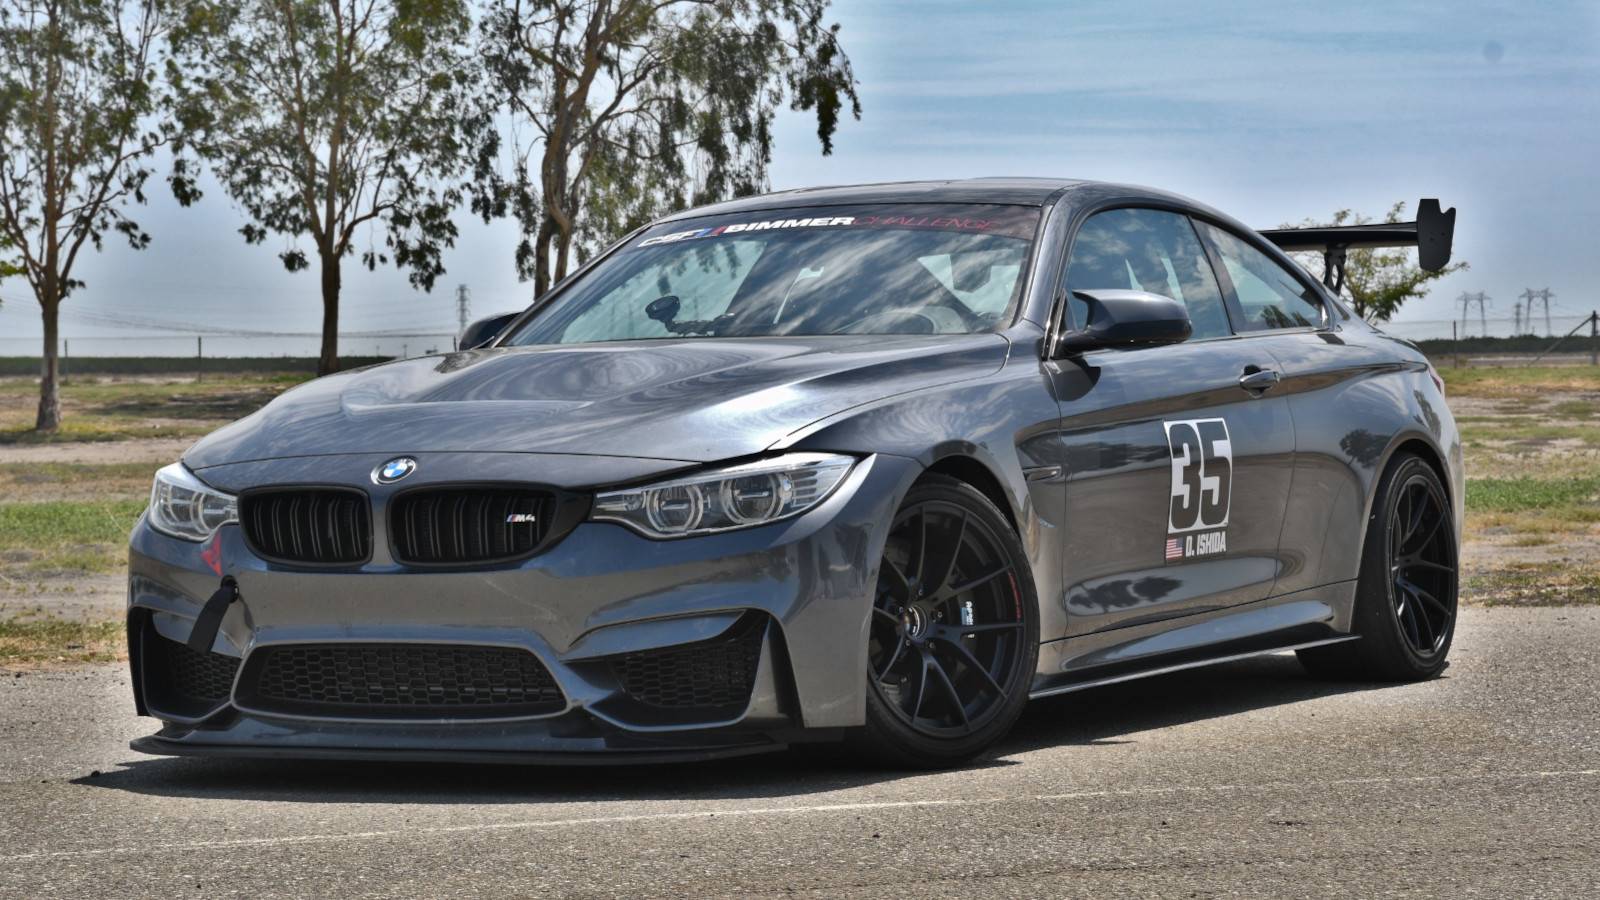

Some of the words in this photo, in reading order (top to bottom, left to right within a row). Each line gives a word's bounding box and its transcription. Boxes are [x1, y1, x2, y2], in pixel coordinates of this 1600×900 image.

[723, 216, 855, 234] BIMMER
[853, 215, 998, 232] CHALLENGE
[1169, 421, 1232, 529] 35
[511, 513, 536, 523] M4
[1185, 535, 1195, 558] D.
[1196, 531, 1227, 556] ISHIDA
